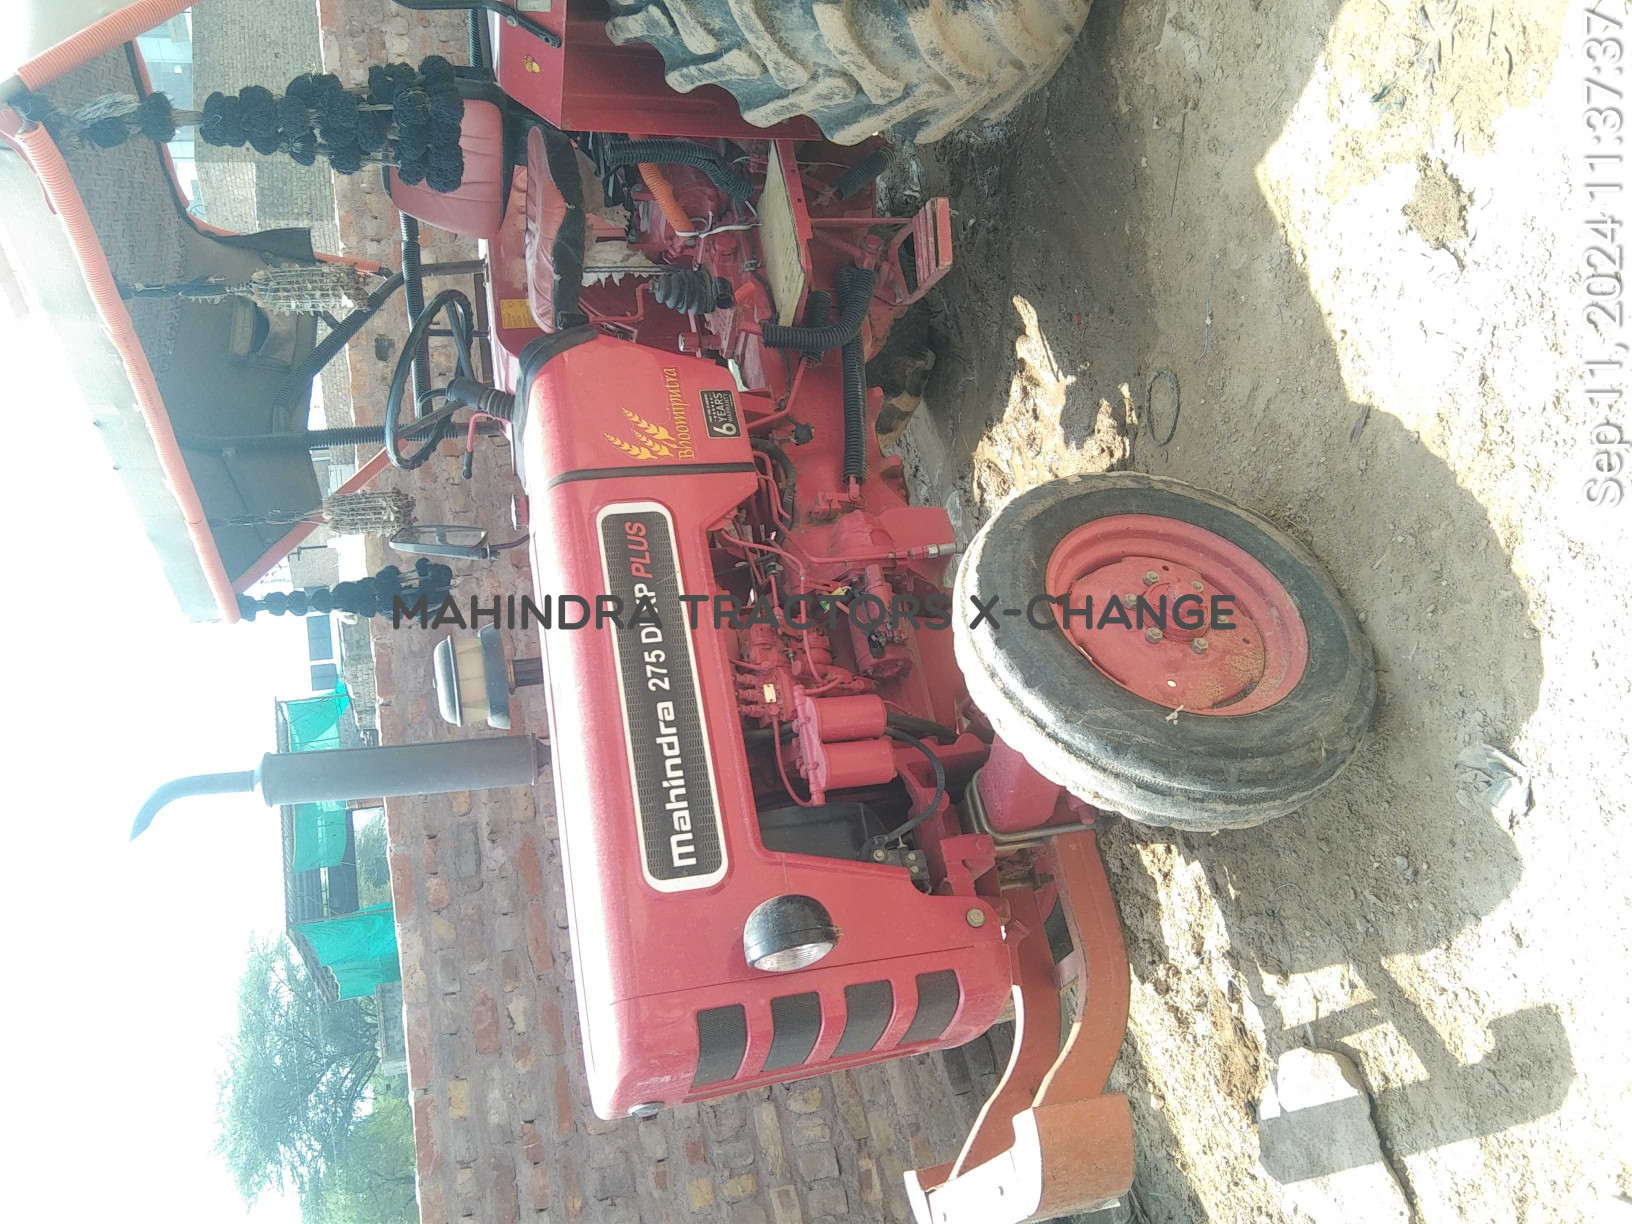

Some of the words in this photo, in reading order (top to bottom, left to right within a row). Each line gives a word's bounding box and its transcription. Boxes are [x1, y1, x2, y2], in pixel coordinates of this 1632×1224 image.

[664, 367, 694, 459] Bhoomiputra
[713, 422, 737, 435] 6
[624, 520, 653, 579] PLUS
[646, 649, 671, 692] 275
